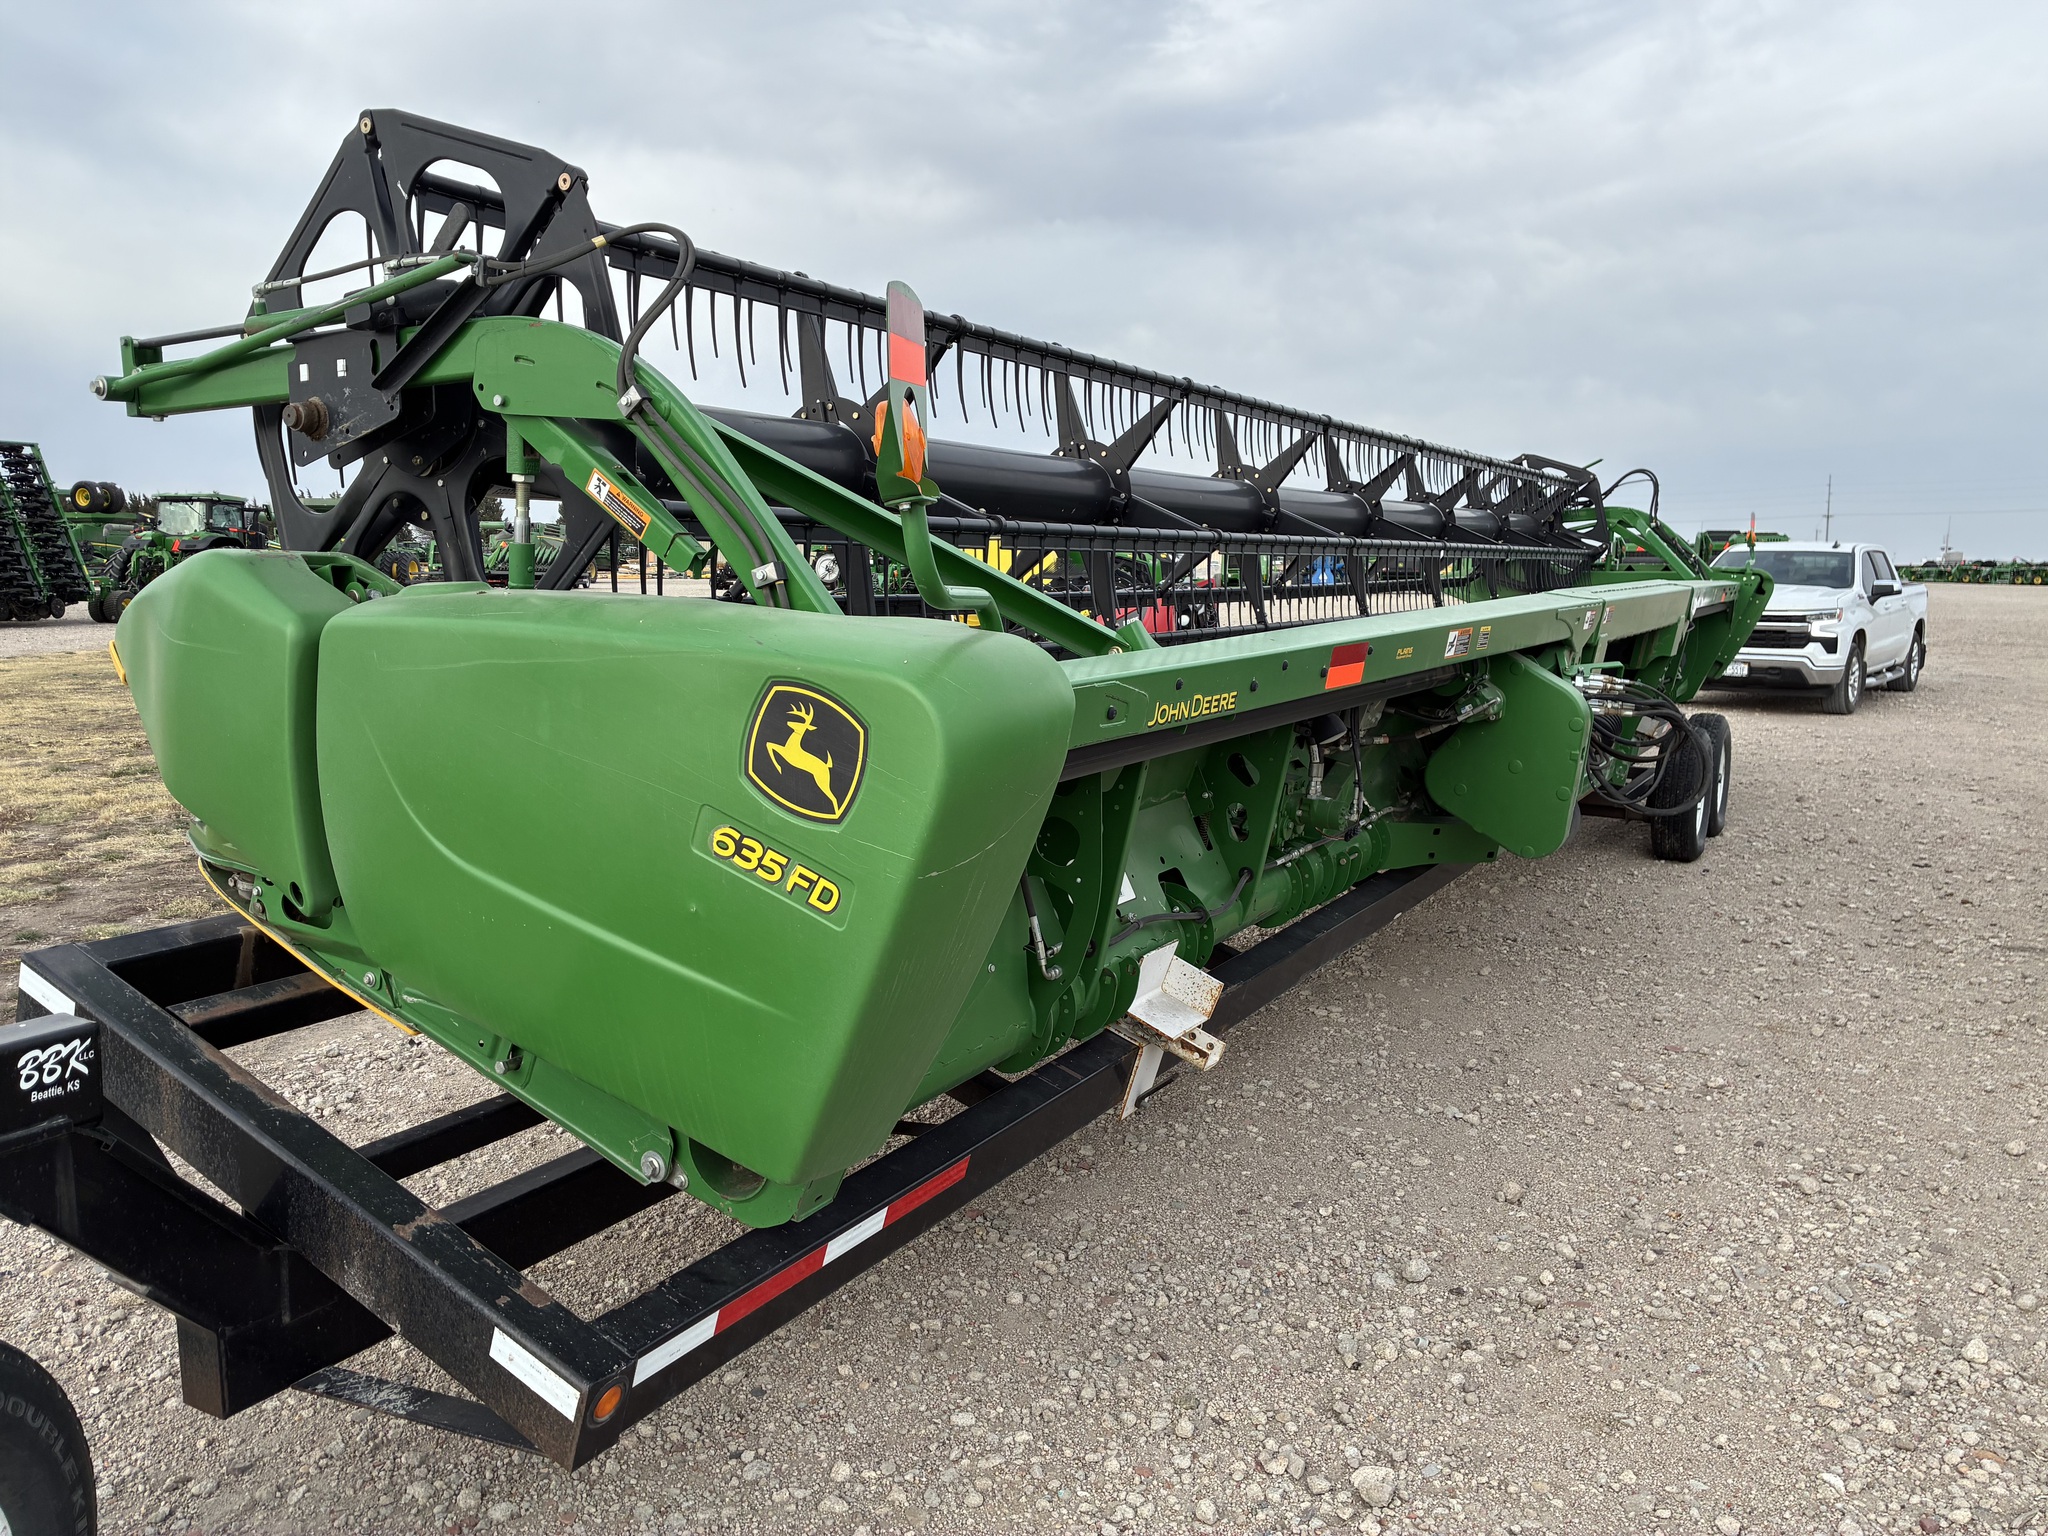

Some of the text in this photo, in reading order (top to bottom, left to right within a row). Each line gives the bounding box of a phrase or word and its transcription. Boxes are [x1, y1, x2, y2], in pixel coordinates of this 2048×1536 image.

[621, 495, 644, 518] WARNING
[1147, 691, 1238, 728] JOHN DEERE
[712, 826, 842, 914] 635 FD
[17, 1037, 95, 1090] BBK LLC
[31, 1080, 80, 1102] Beattie, KS
